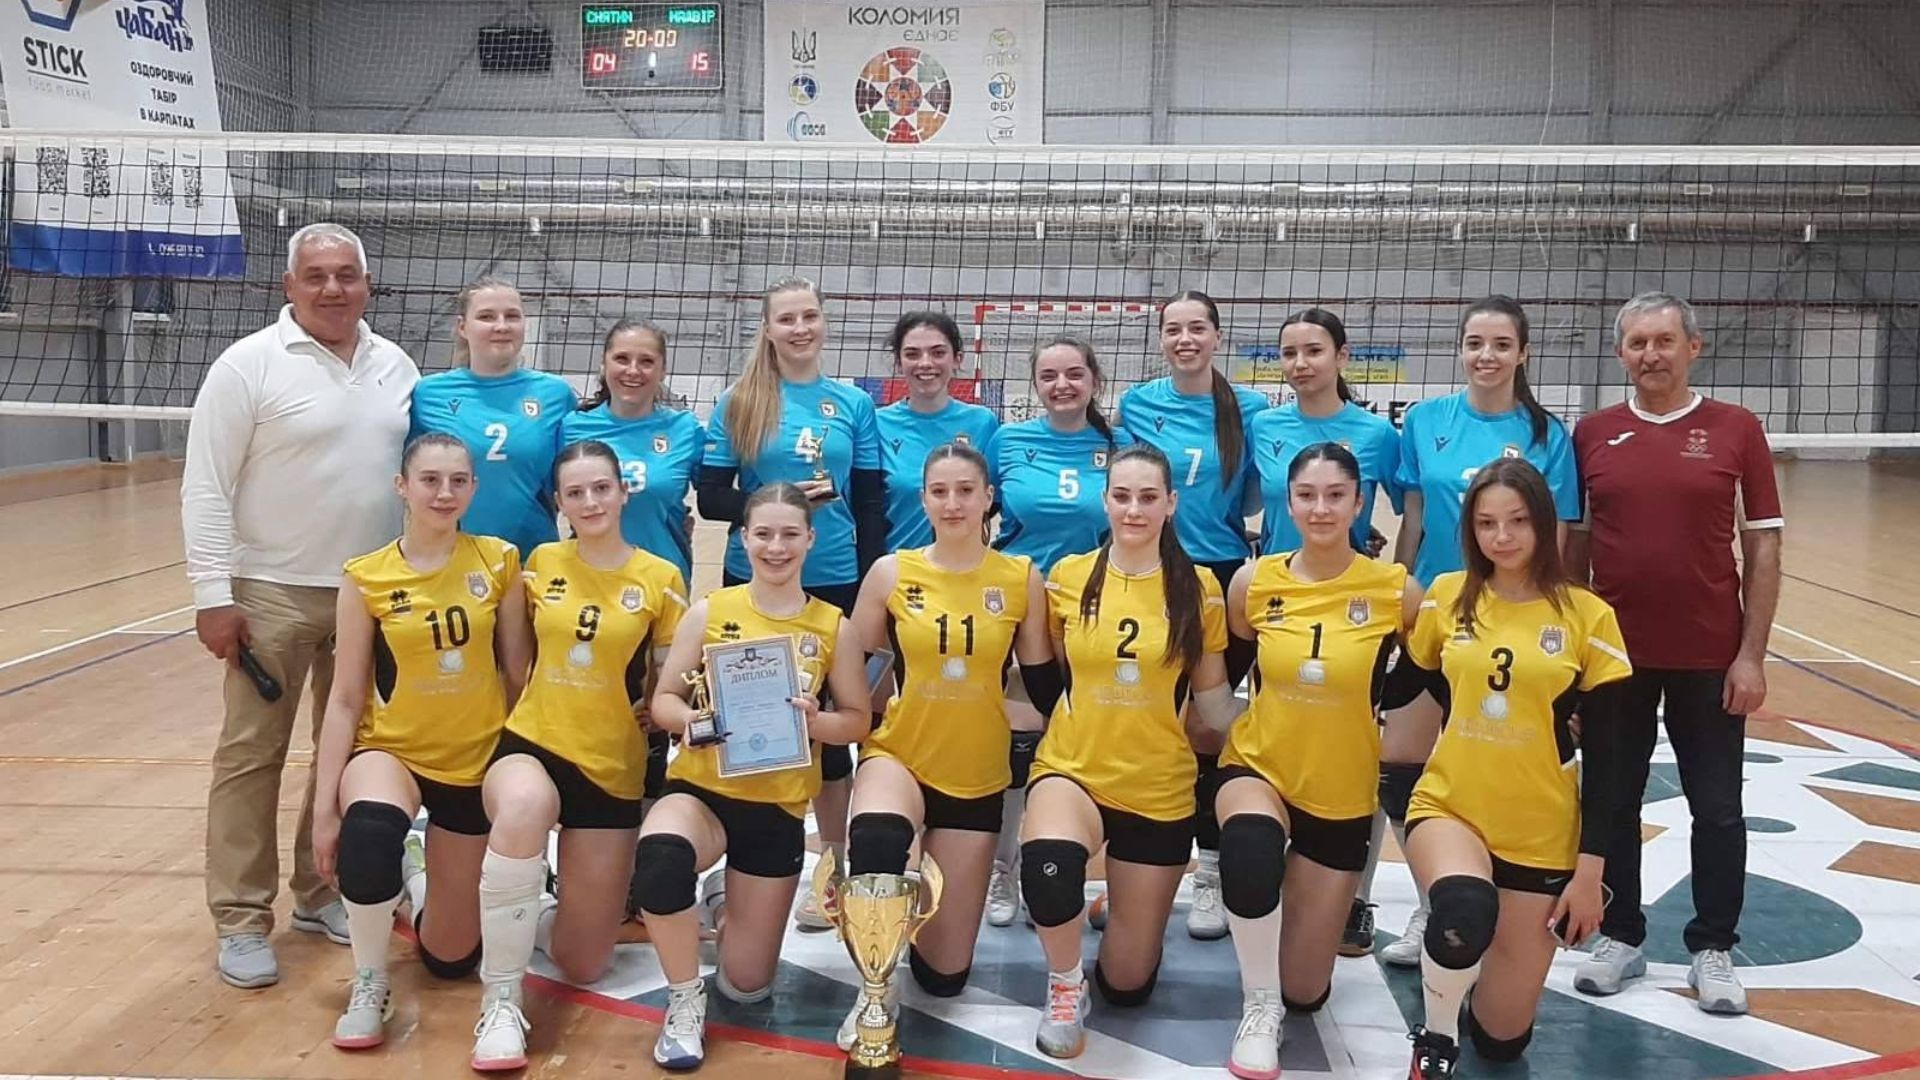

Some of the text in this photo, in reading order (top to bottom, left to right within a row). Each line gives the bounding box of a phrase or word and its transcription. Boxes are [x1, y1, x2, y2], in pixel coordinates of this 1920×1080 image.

[848, 6, 960, 25] КОЛОМИЯ
[23, 36, 88, 78] STICK
[130, 61, 194, 87] ОЗДОРОВЧИЙ
[592, 52, 616, 71] 04
[691, 52, 709, 71] 15
[151, 88, 178, 104] ТАБІР
[990, 101, 1015, 112] ФБУ
[140, 108, 196, 130] В КАРПАТАХ
[484, 423, 509, 461] 2
[795, 427, 818, 464] 4
[1058, 469, 1080, 499] 5
[1184, 448, 1203, 486] 7
[425, 605, 470, 650] 10
[575, 604, 601, 642] 9
[935, 613, 974, 656] 11
[1117, 617, 1140, 659] 2
[1309, 622, 1322, 659] 1
[731, 669, 778, 685] ДИПЛОМ
[1487, 647, 1514, 692] 3
